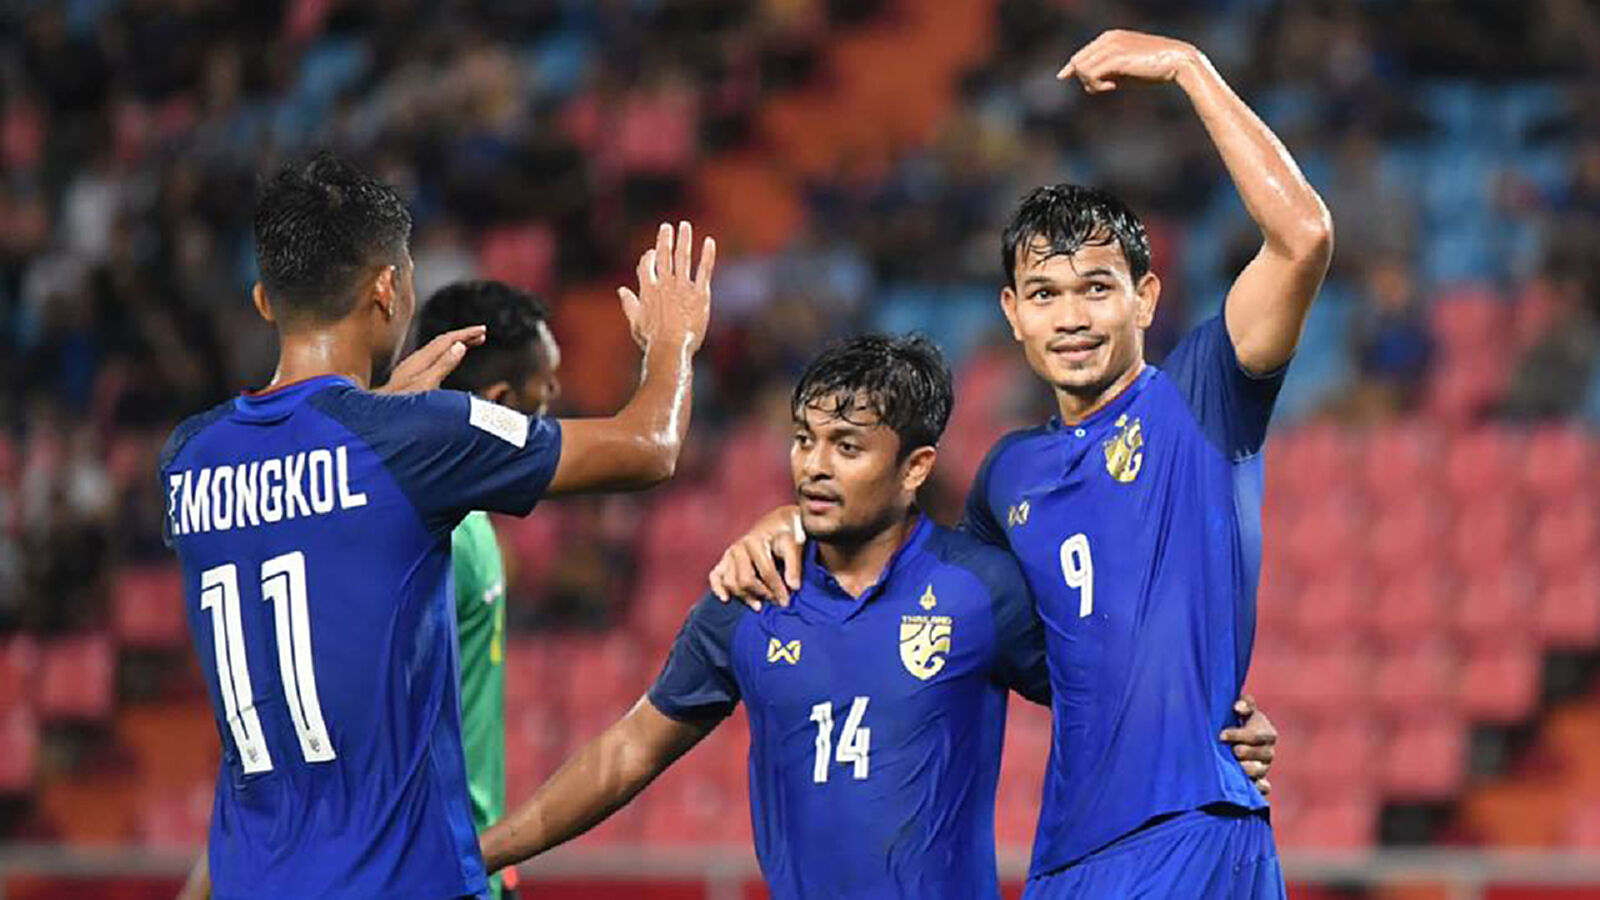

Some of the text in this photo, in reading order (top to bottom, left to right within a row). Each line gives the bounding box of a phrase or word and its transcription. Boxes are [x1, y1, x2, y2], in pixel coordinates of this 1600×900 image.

[1060, 533, 1094, 618] 9
[201, 550, 336, 774] 11
[809, 696, 870, 783] 14
